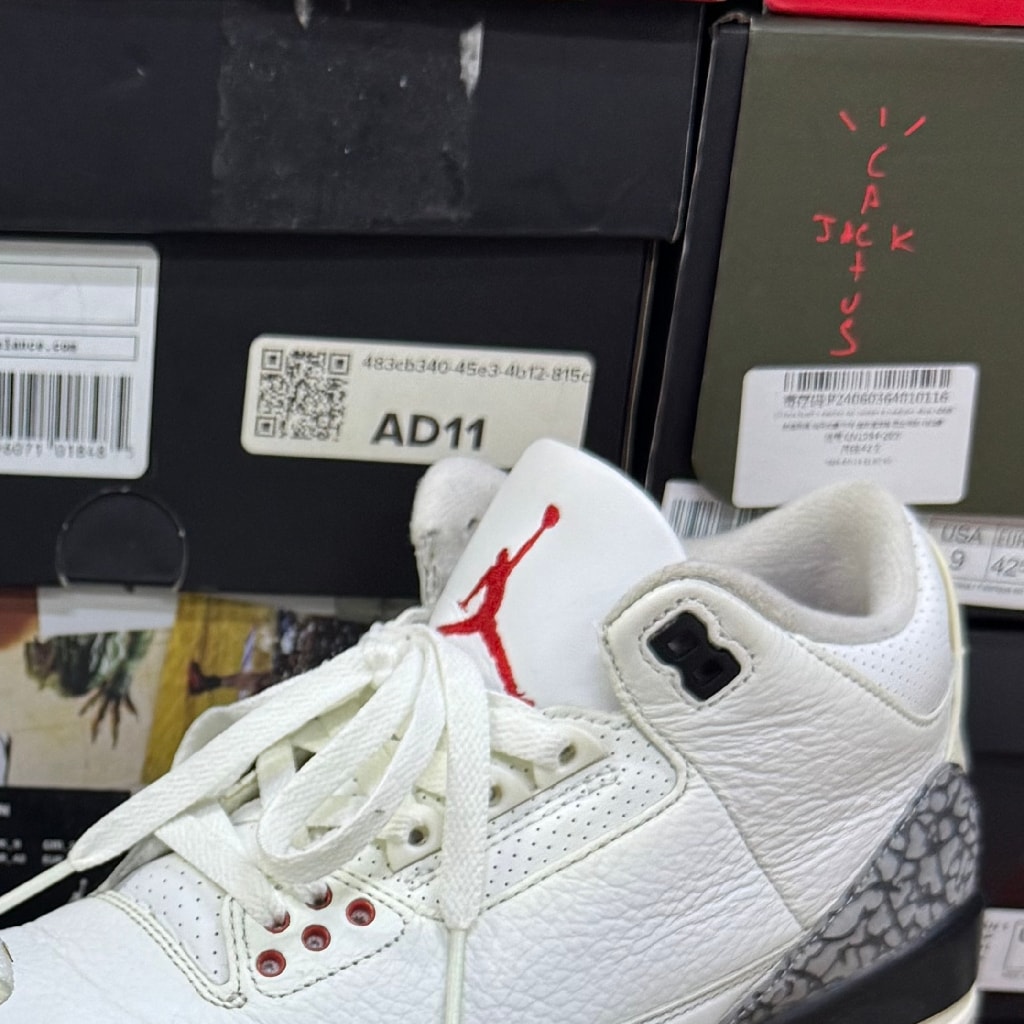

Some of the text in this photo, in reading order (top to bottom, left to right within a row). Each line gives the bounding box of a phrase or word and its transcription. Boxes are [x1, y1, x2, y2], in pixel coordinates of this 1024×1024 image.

[370, 412, 487, 453] AD11
[941, 524, 984, 544] USA
[950, 549, 966, 570] 9
